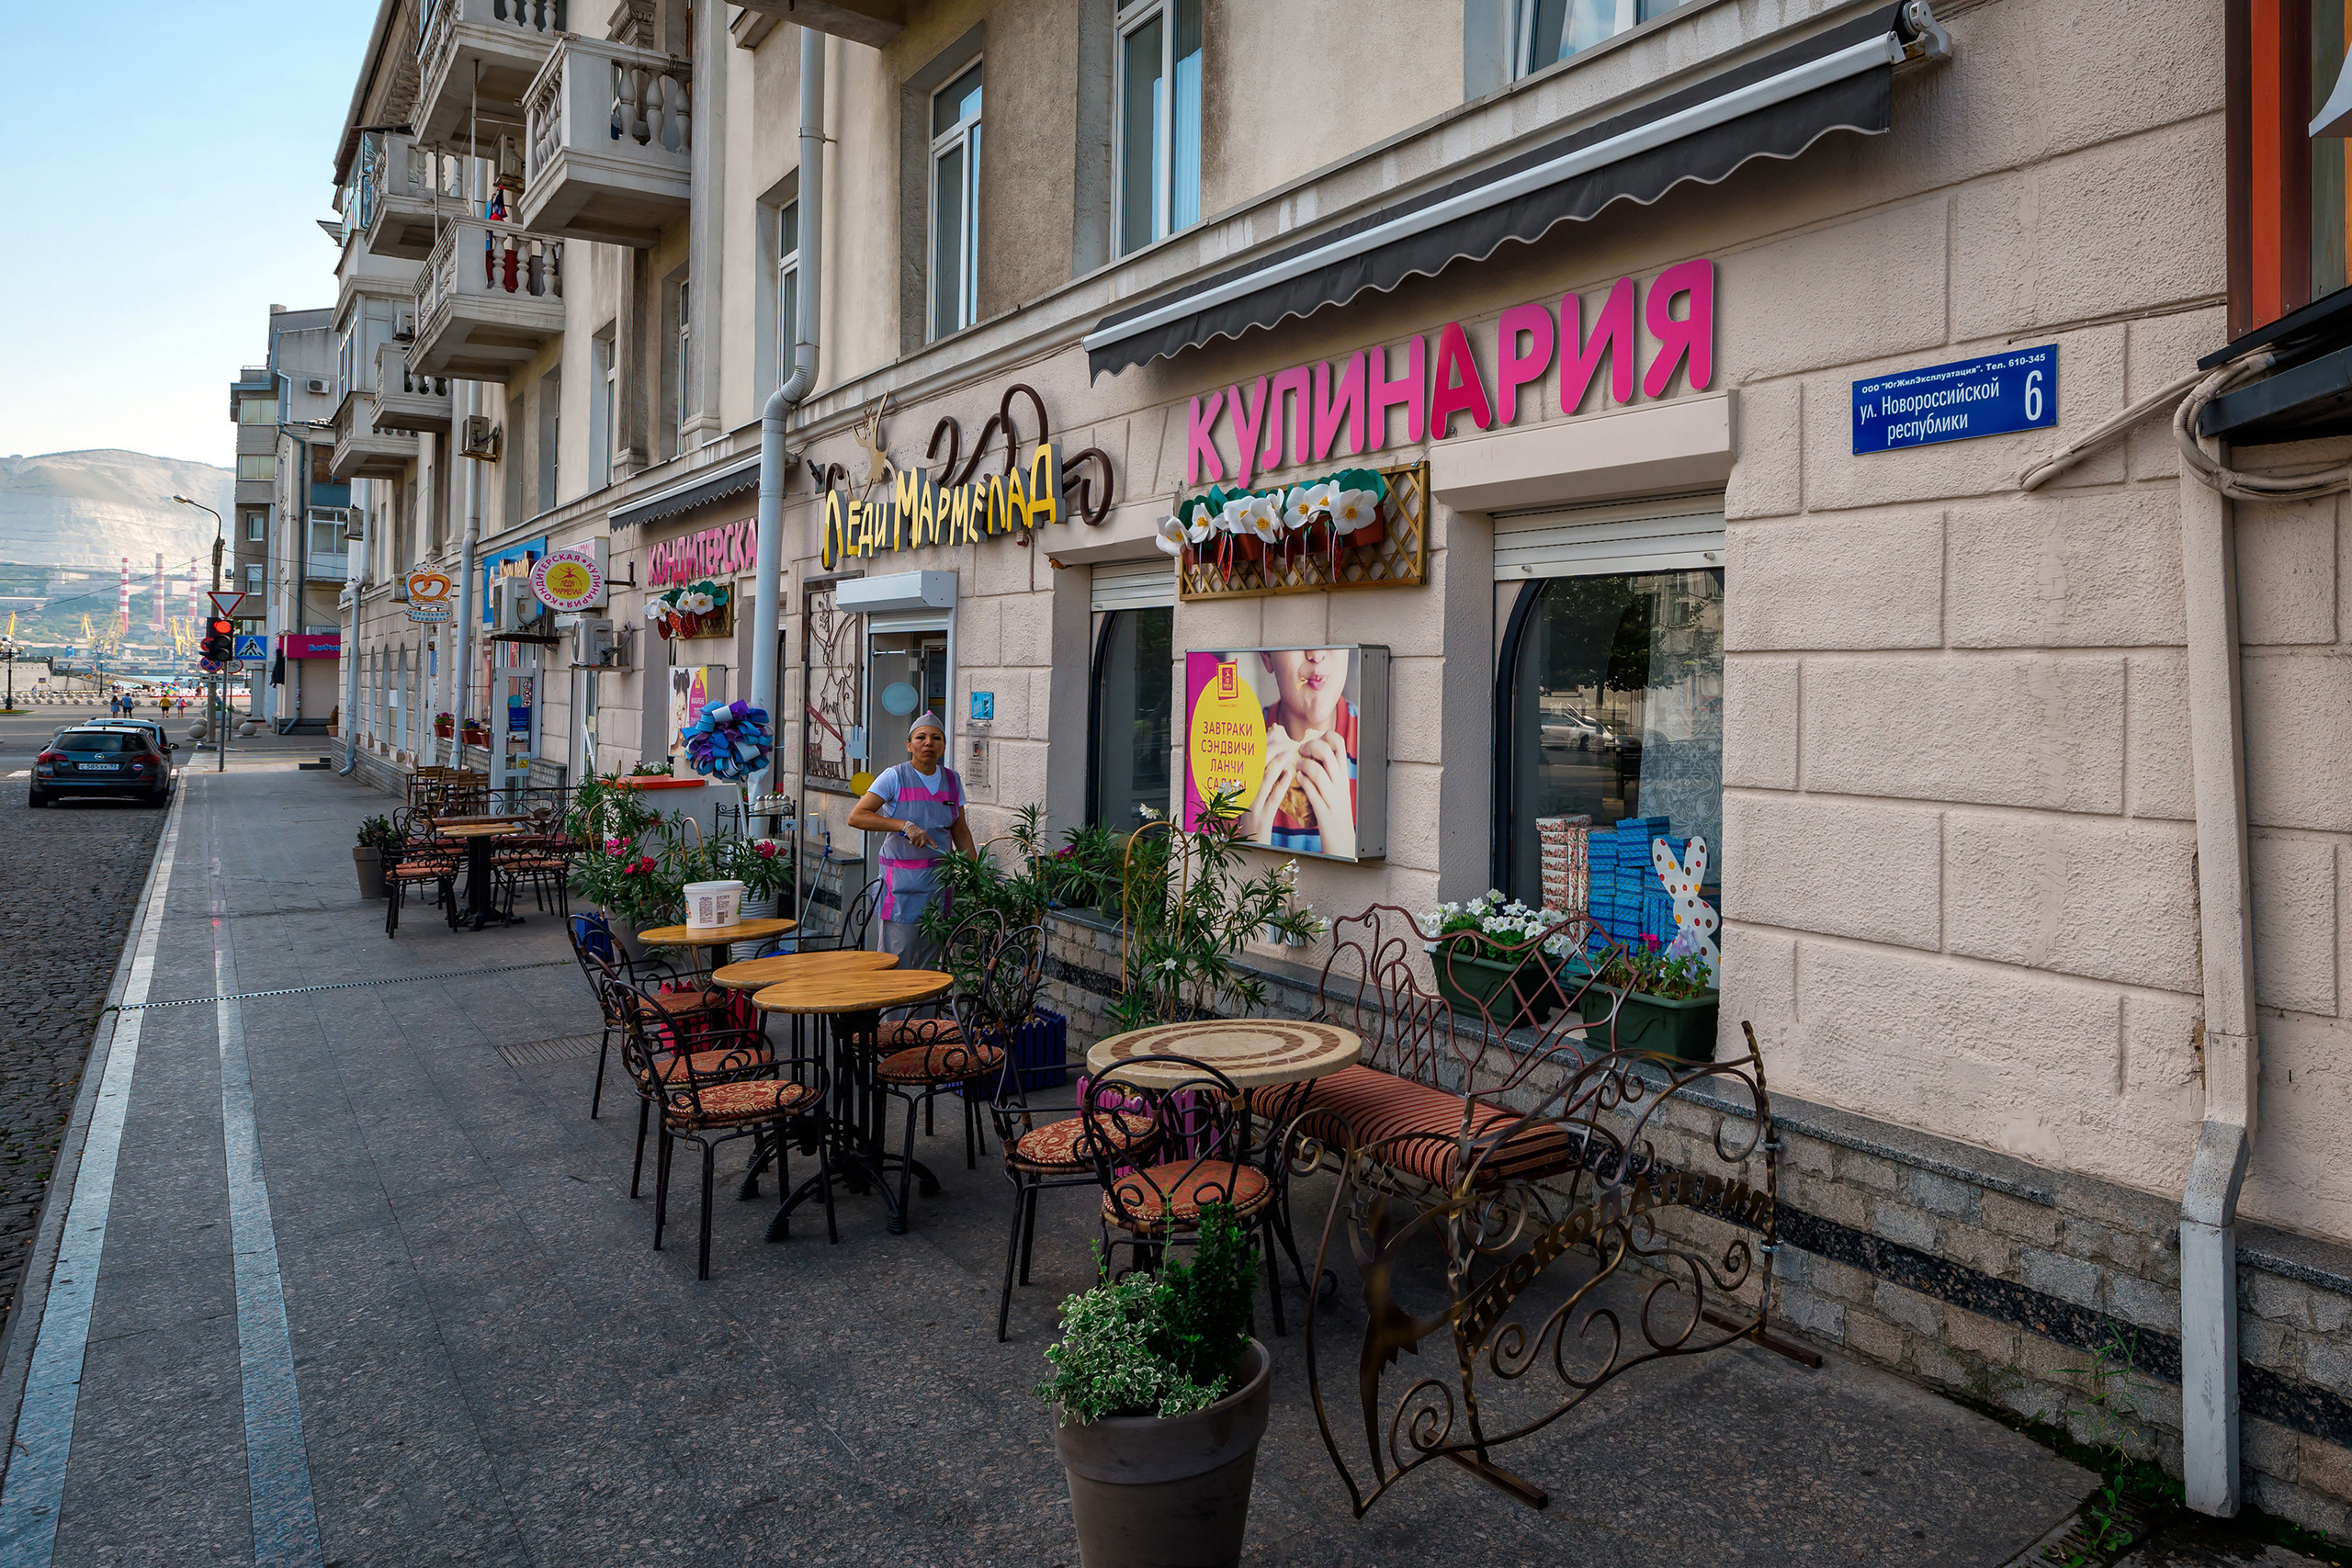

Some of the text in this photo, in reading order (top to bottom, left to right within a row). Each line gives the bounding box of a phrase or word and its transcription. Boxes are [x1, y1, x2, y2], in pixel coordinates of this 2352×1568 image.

[1188, 258, 1714, 490] КУЛИНАРИЯ
[1861, 383, 1880, 394] ООО
[1985, 362, 2007, 372] Тел.
[2008, 353, 2046, 367] 610-345
[2024, 369, 2043, 421] 6
[1860, 377, 1999, 424] ул. Новороссийской
[1887, 412, 1969, 446] республики
[648, 518, 759, 588] КОНДИТЕРСКА
[535, 553, 581, 606] КОНДИТЕРСКАЯ
[566, 562, 602, 608] КУЛИНАРИЯ
[1201, 739, 1255, 757] СЭНДВИЧИ
[1203, 721, 1253, 738] ЗАВТРАКИ
[1209, 758, 1244, 774] ЛАНЧИ
